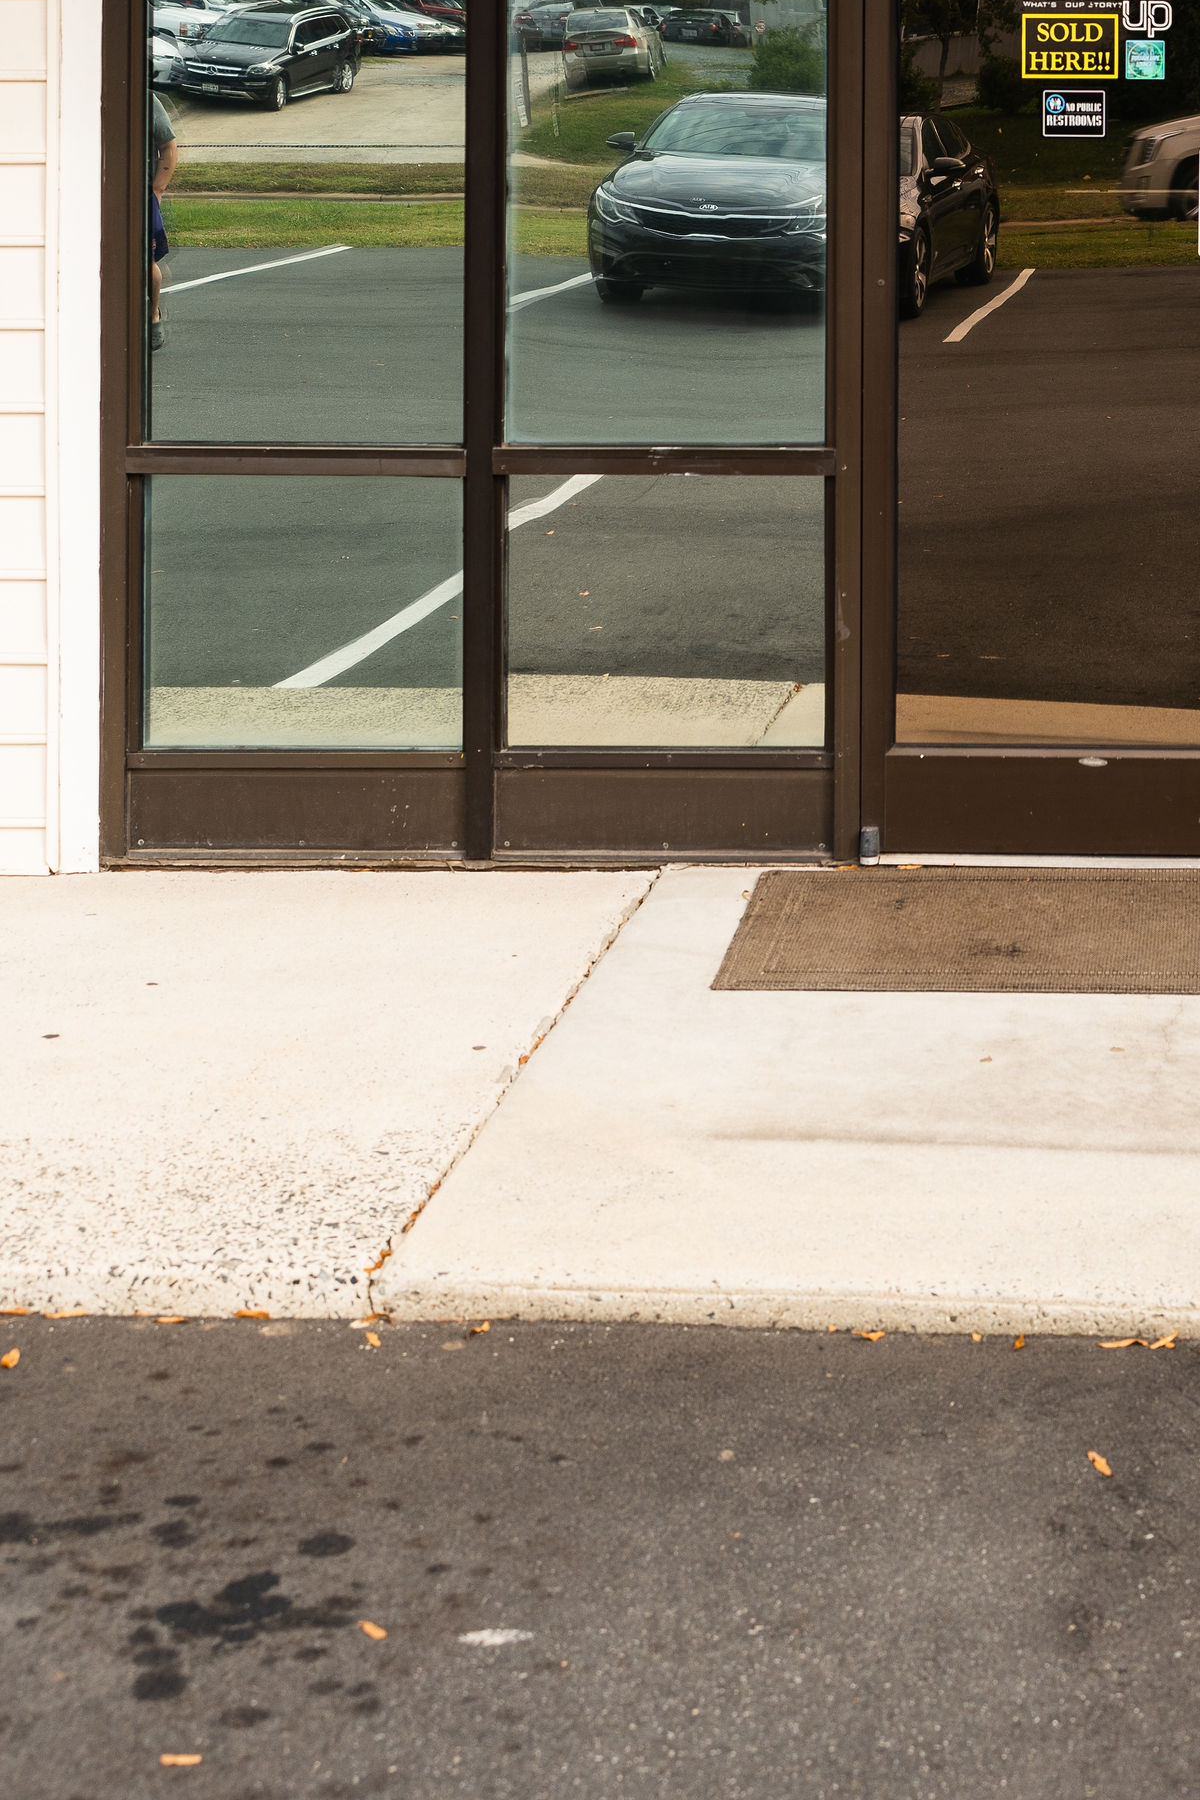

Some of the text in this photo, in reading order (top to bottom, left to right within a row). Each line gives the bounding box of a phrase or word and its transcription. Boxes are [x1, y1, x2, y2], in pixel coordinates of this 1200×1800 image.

[1122, 0, 1173, 38] up
[1036, 22, 1103, 42] SOLD
[1029, 51, 1111, 72] HERE!!
[1065, 102, 1102, 112] NO PUBLIC
[1046, 114, 1102, 127] RESTROOMS
